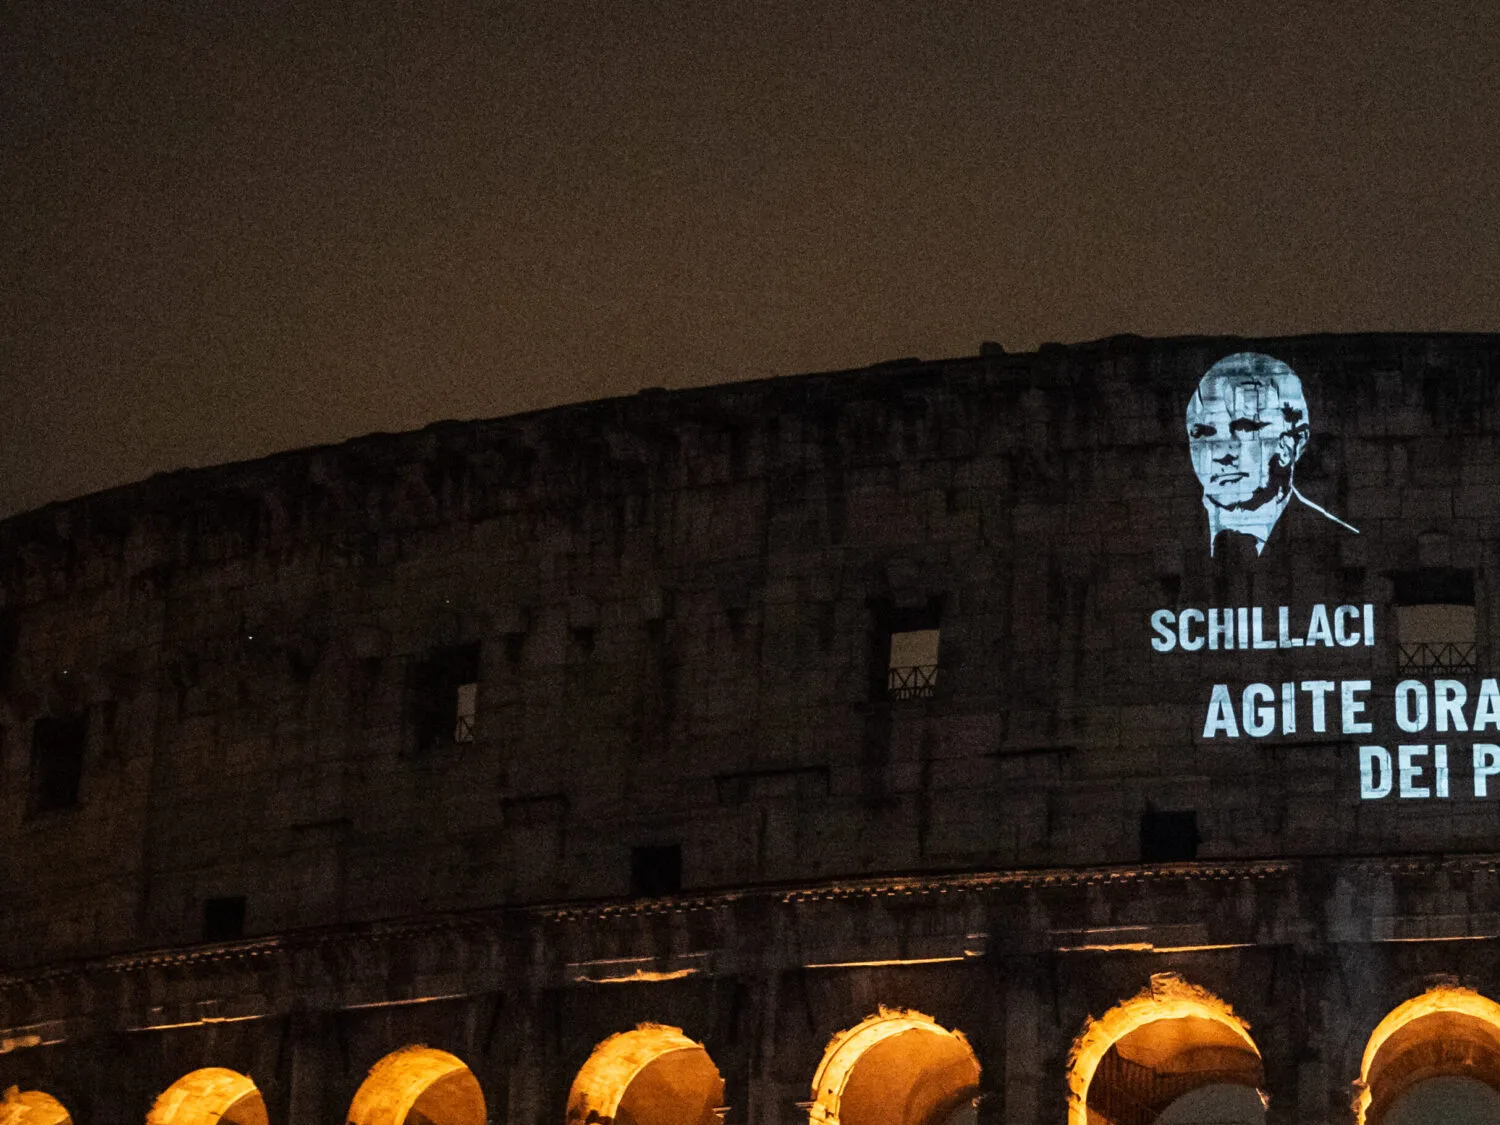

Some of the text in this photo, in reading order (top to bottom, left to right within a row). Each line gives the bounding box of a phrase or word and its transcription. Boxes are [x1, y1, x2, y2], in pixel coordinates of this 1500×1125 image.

[1151, 604, 1376, 653] SCHILLACI
[1203, 680, 1374, 738] AGITE
[1358, 744, 1450, 800] DEI
